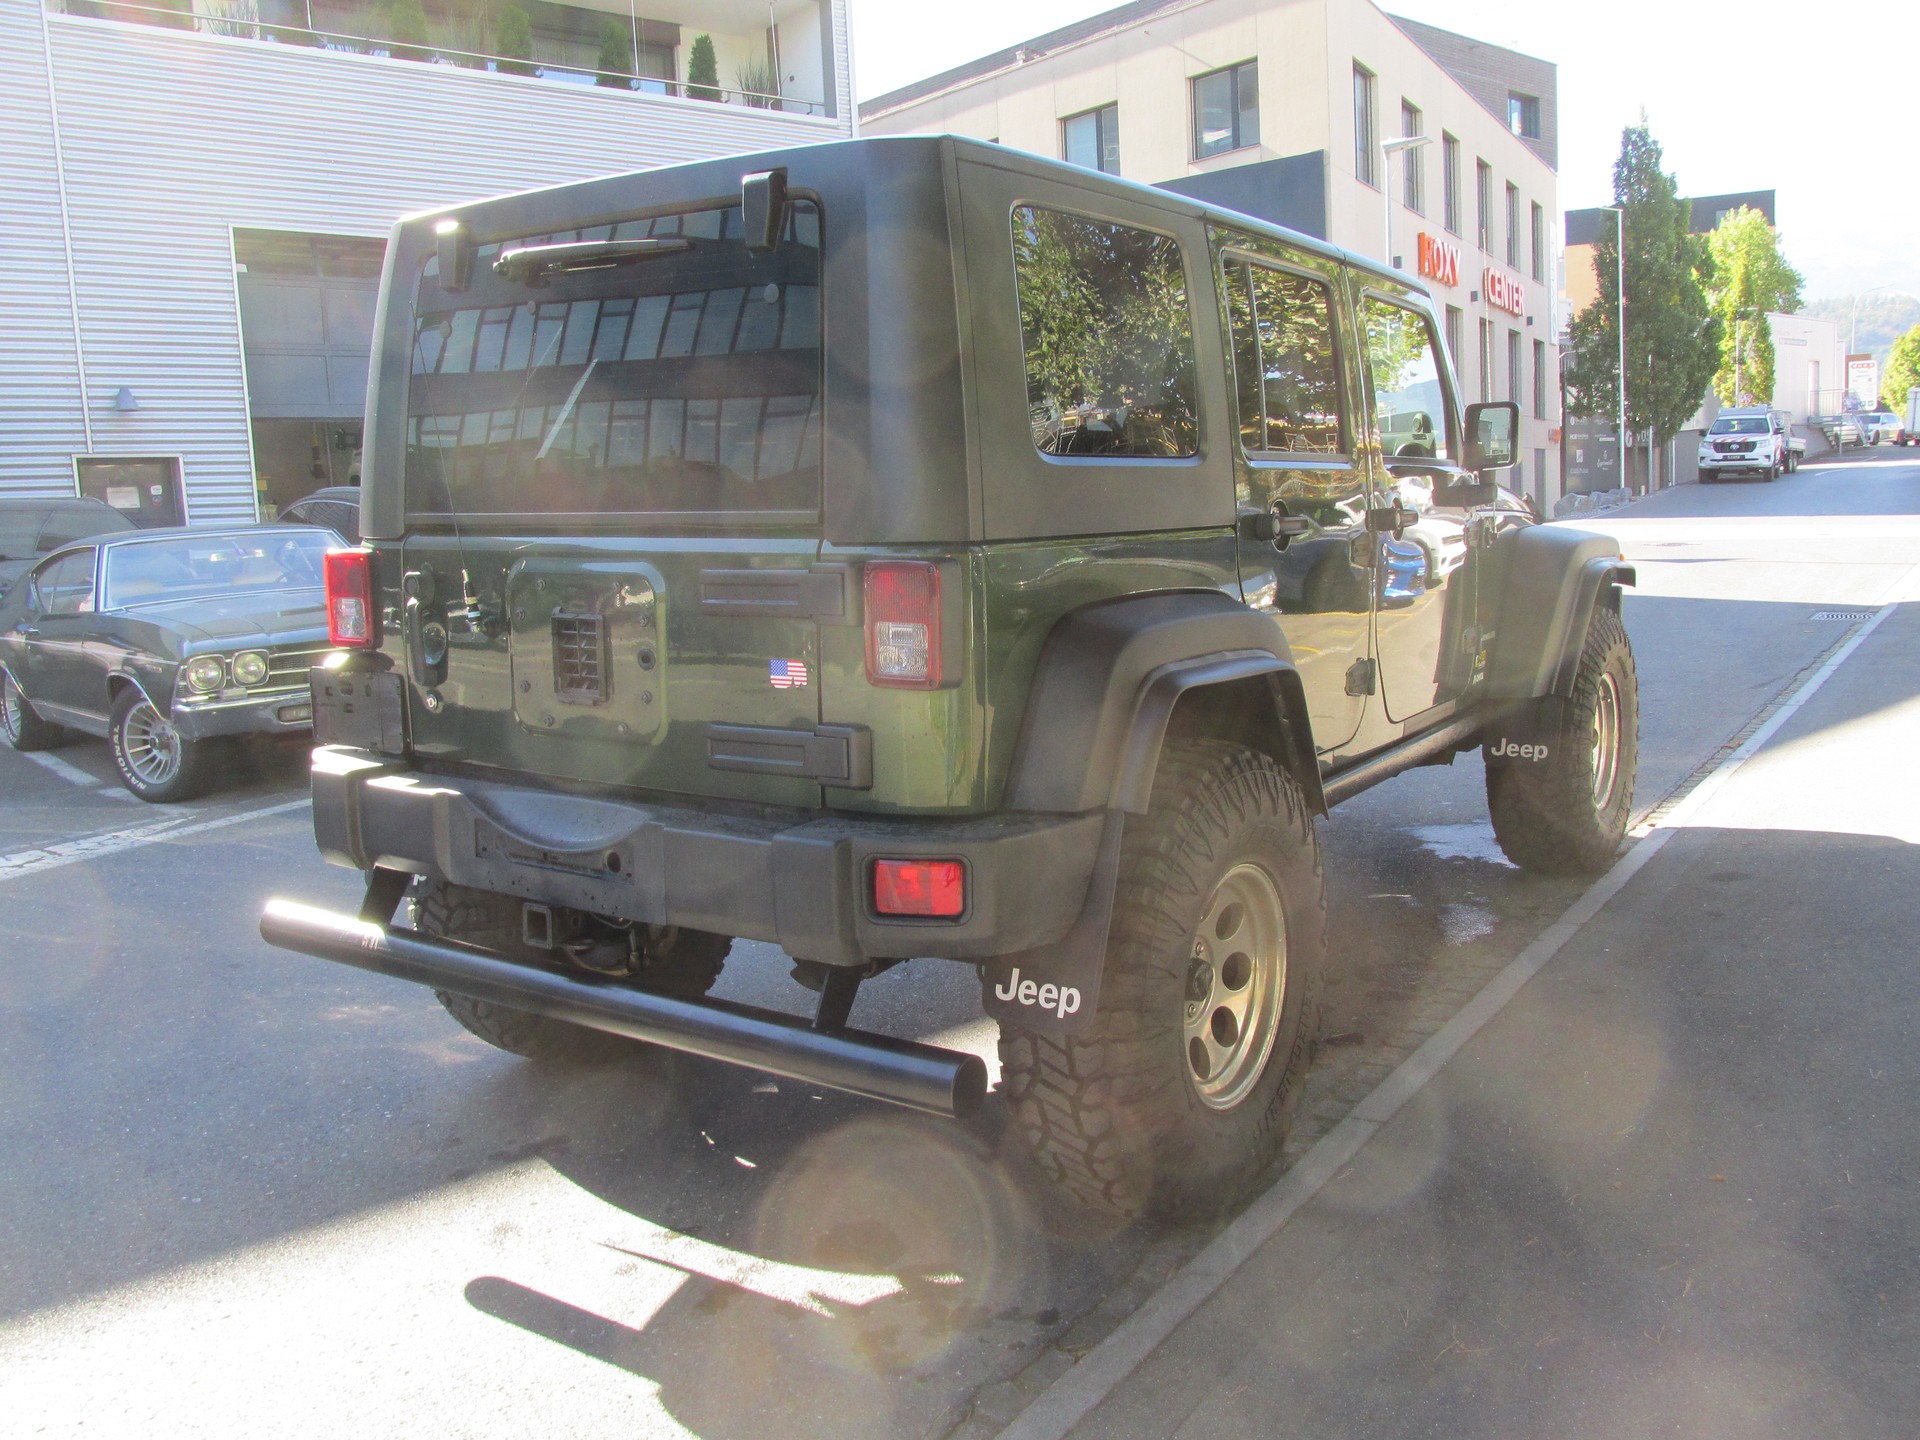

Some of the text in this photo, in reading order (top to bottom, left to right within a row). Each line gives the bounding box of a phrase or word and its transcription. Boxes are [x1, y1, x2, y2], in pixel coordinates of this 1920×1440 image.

[1417, 232, 1461, 287] ROXY
[1482, 267, 1525, 317] CENTER
[1850, 362, 1875, 370] coop
[113, 725, 147, 790] NATIONAL
[1491, 738, 1548, 762] Jeep
[995, 967, 1081, 1019] Jeep
